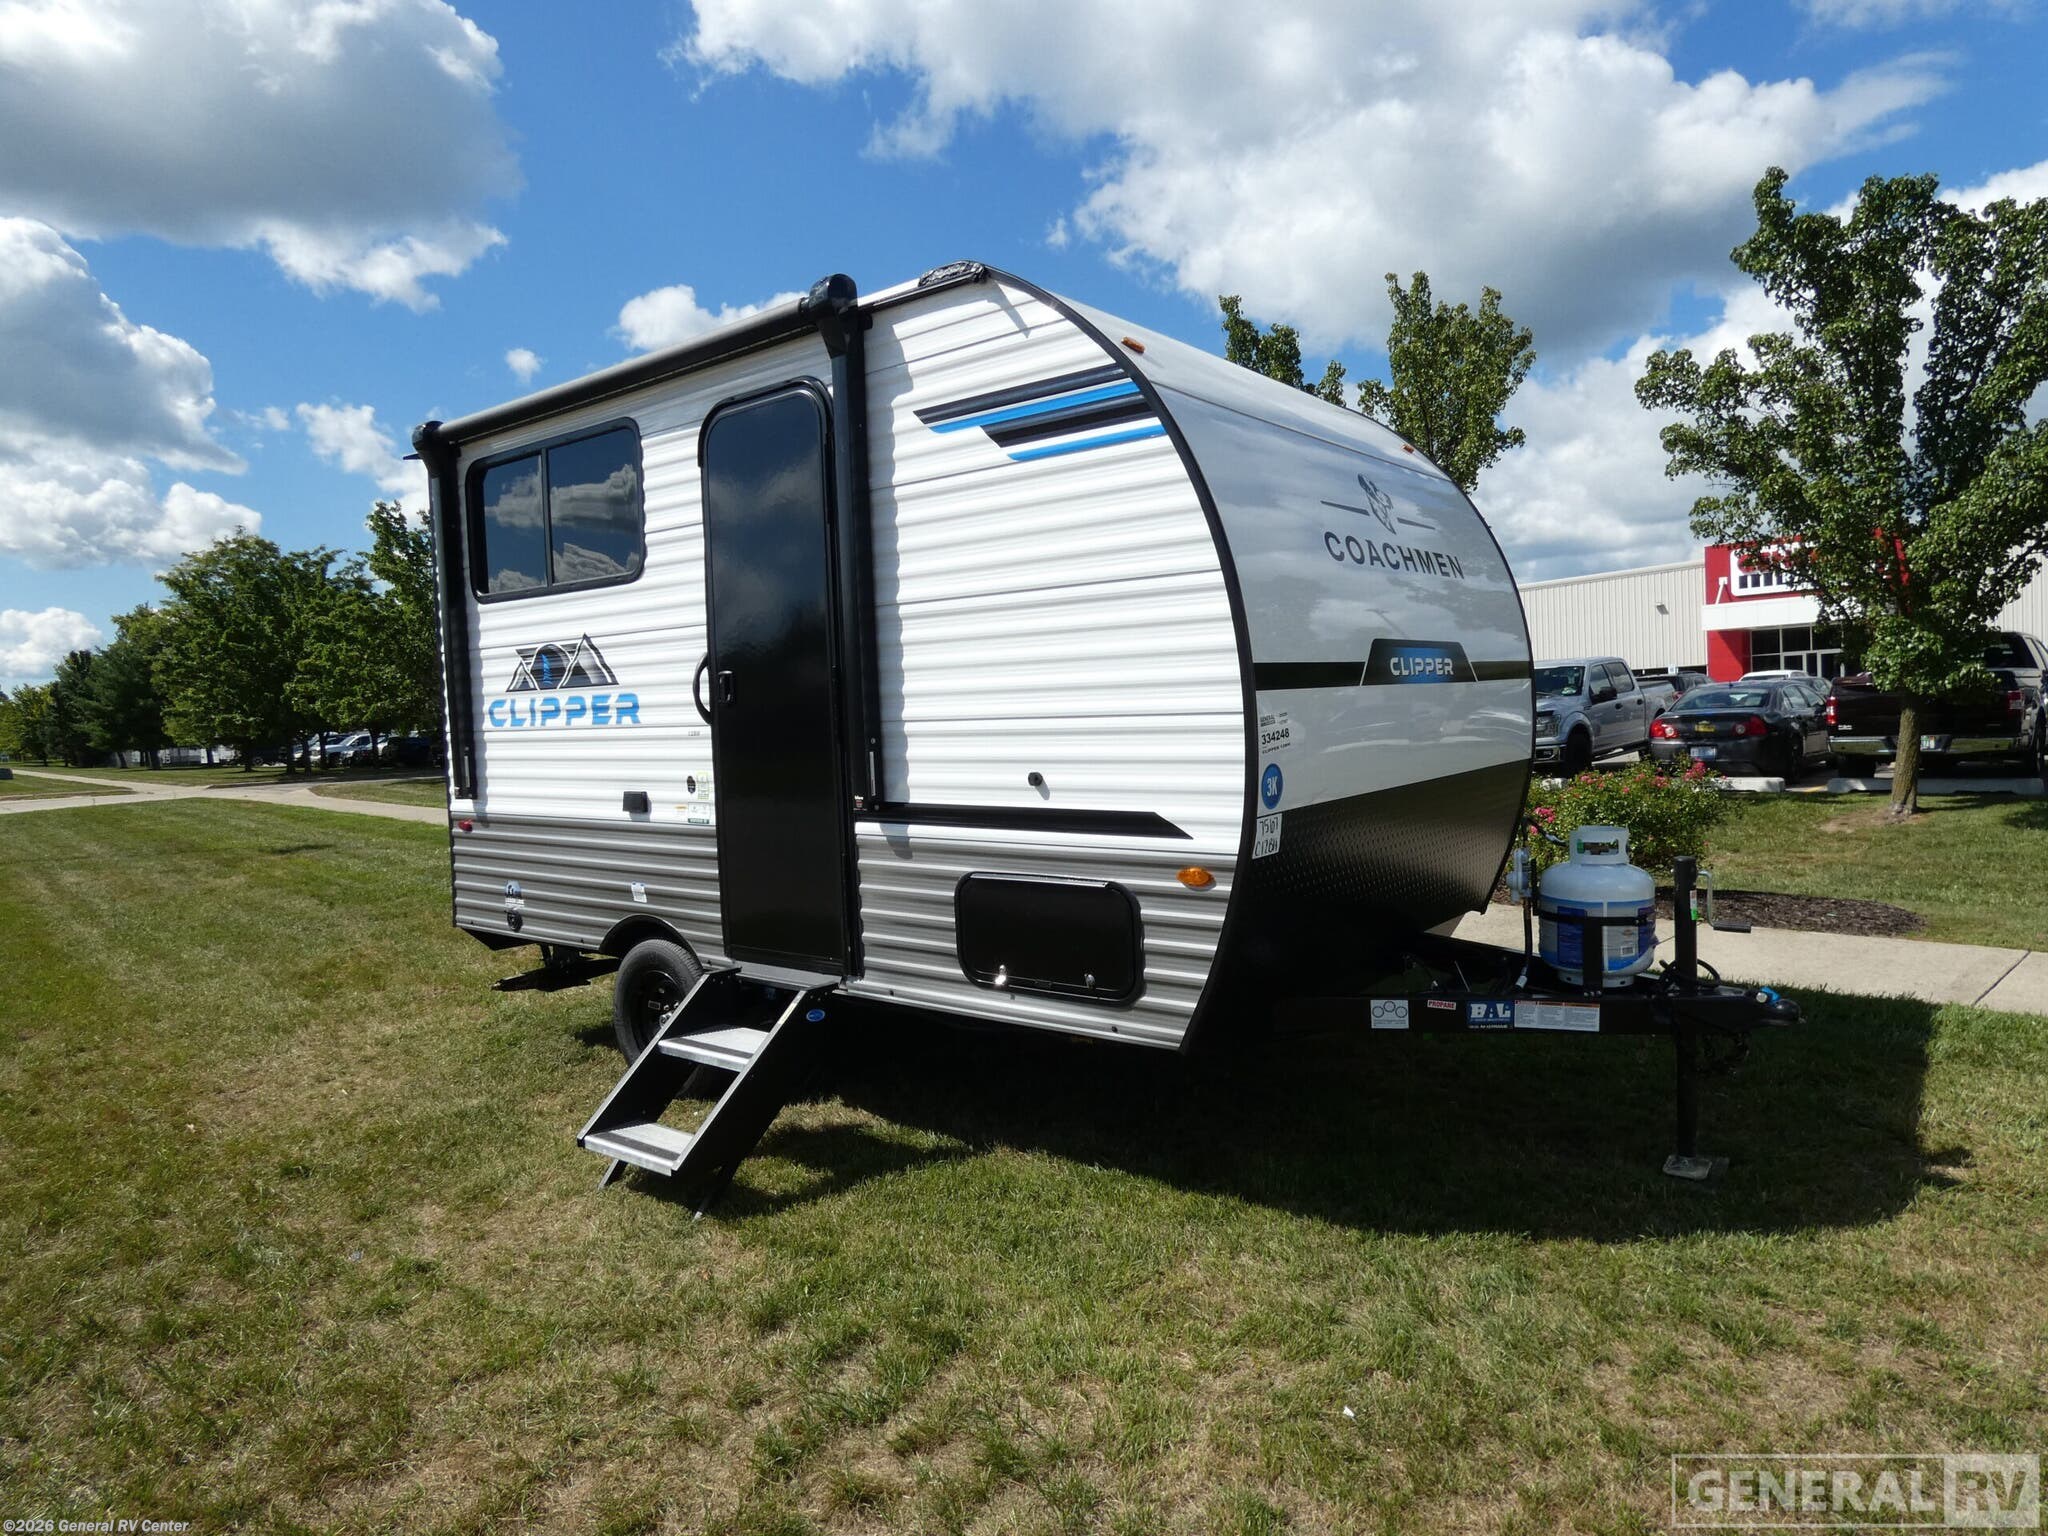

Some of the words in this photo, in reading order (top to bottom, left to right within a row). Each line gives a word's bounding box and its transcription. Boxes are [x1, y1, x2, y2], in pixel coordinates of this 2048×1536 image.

[1324, 531, 1465, 580] COACHMEN
[1389, 657, 1455, 676] CLIPPER
[488, 692, 641, 728] CLIPPER
[1261, 727, 1290, 745] 334248
[1266, 775, 1278, 797] 3K
[1428, 1000, 1456, 1009] PROPANE
